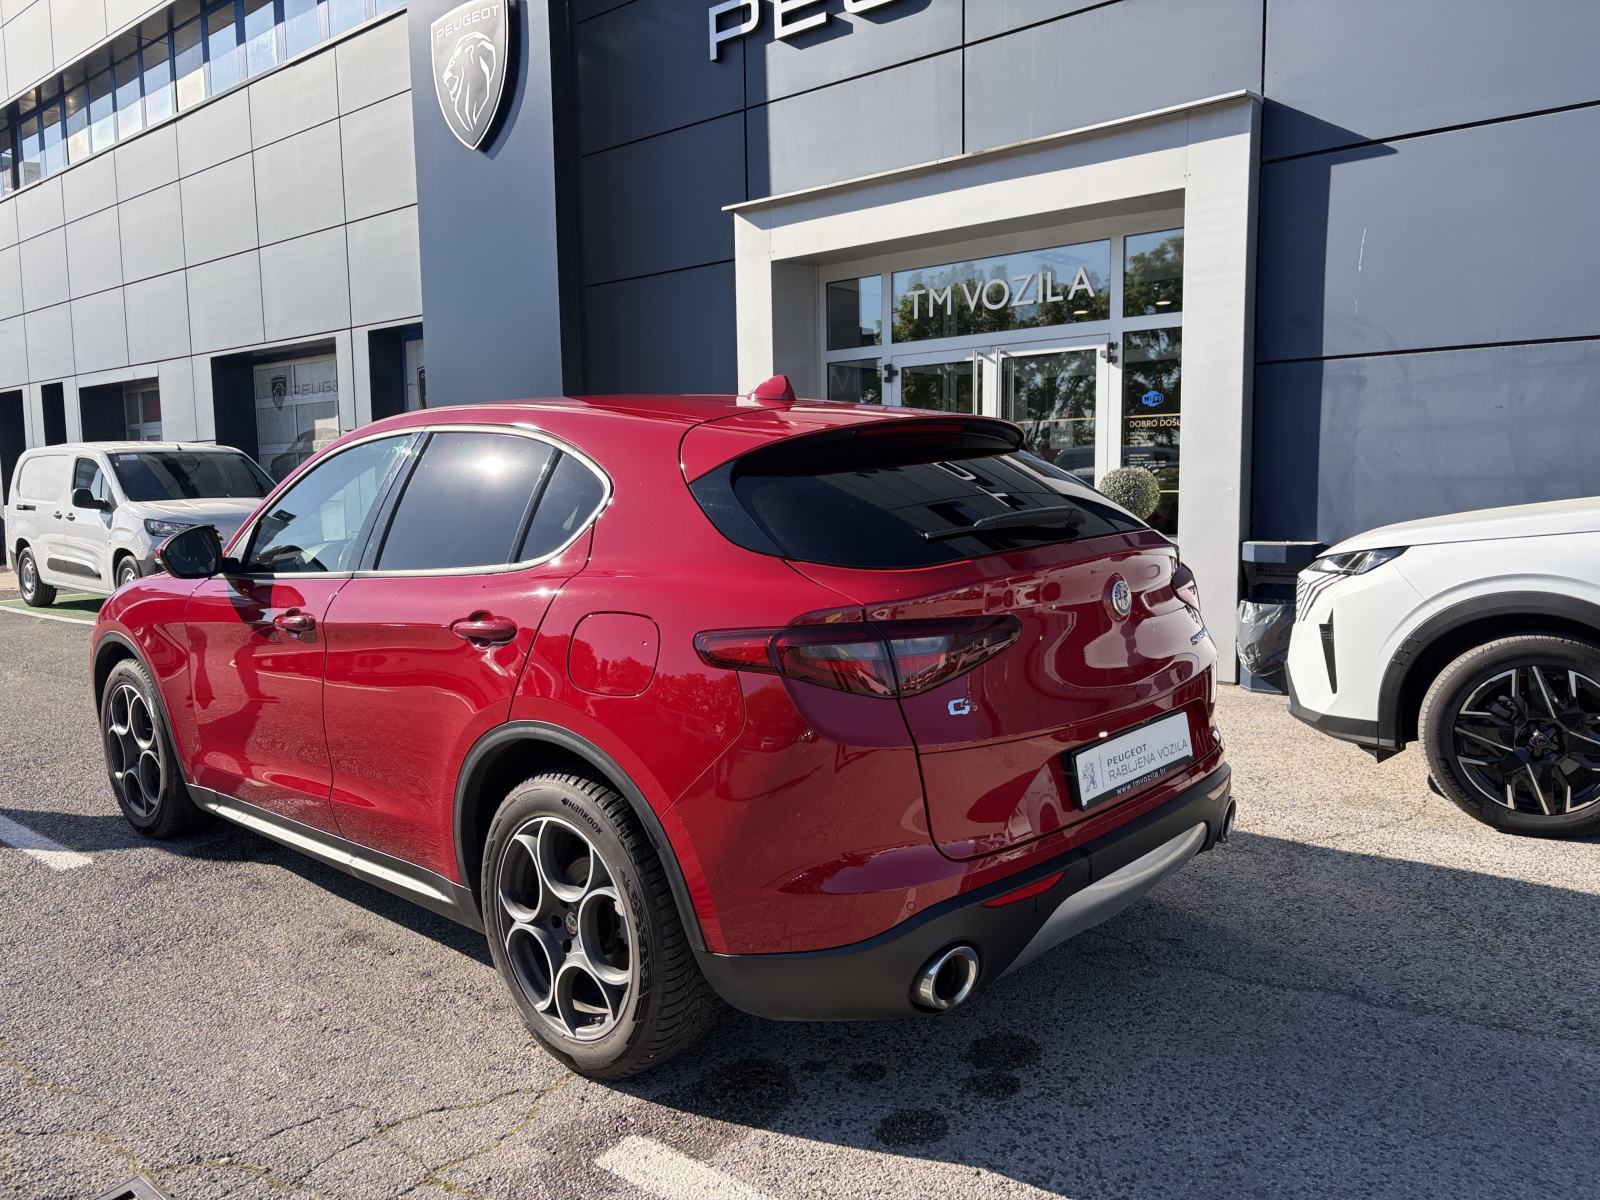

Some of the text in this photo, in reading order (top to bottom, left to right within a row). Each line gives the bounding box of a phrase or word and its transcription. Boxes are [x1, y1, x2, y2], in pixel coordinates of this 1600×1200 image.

[436, 5, 500, 42] PEUGEOT
[708, 0, 903, 61] PE
[907, 266, 1096, 320] TM VOZILA
[1129, 420, 1157, 428] DOBRO
[1106, 743, 1147, 767] PEUGEOT
[1108, 739, 1188, 781] RABLJENA VOZILA
[1116, 767, 1167, 795] www.tmvozila.hr
